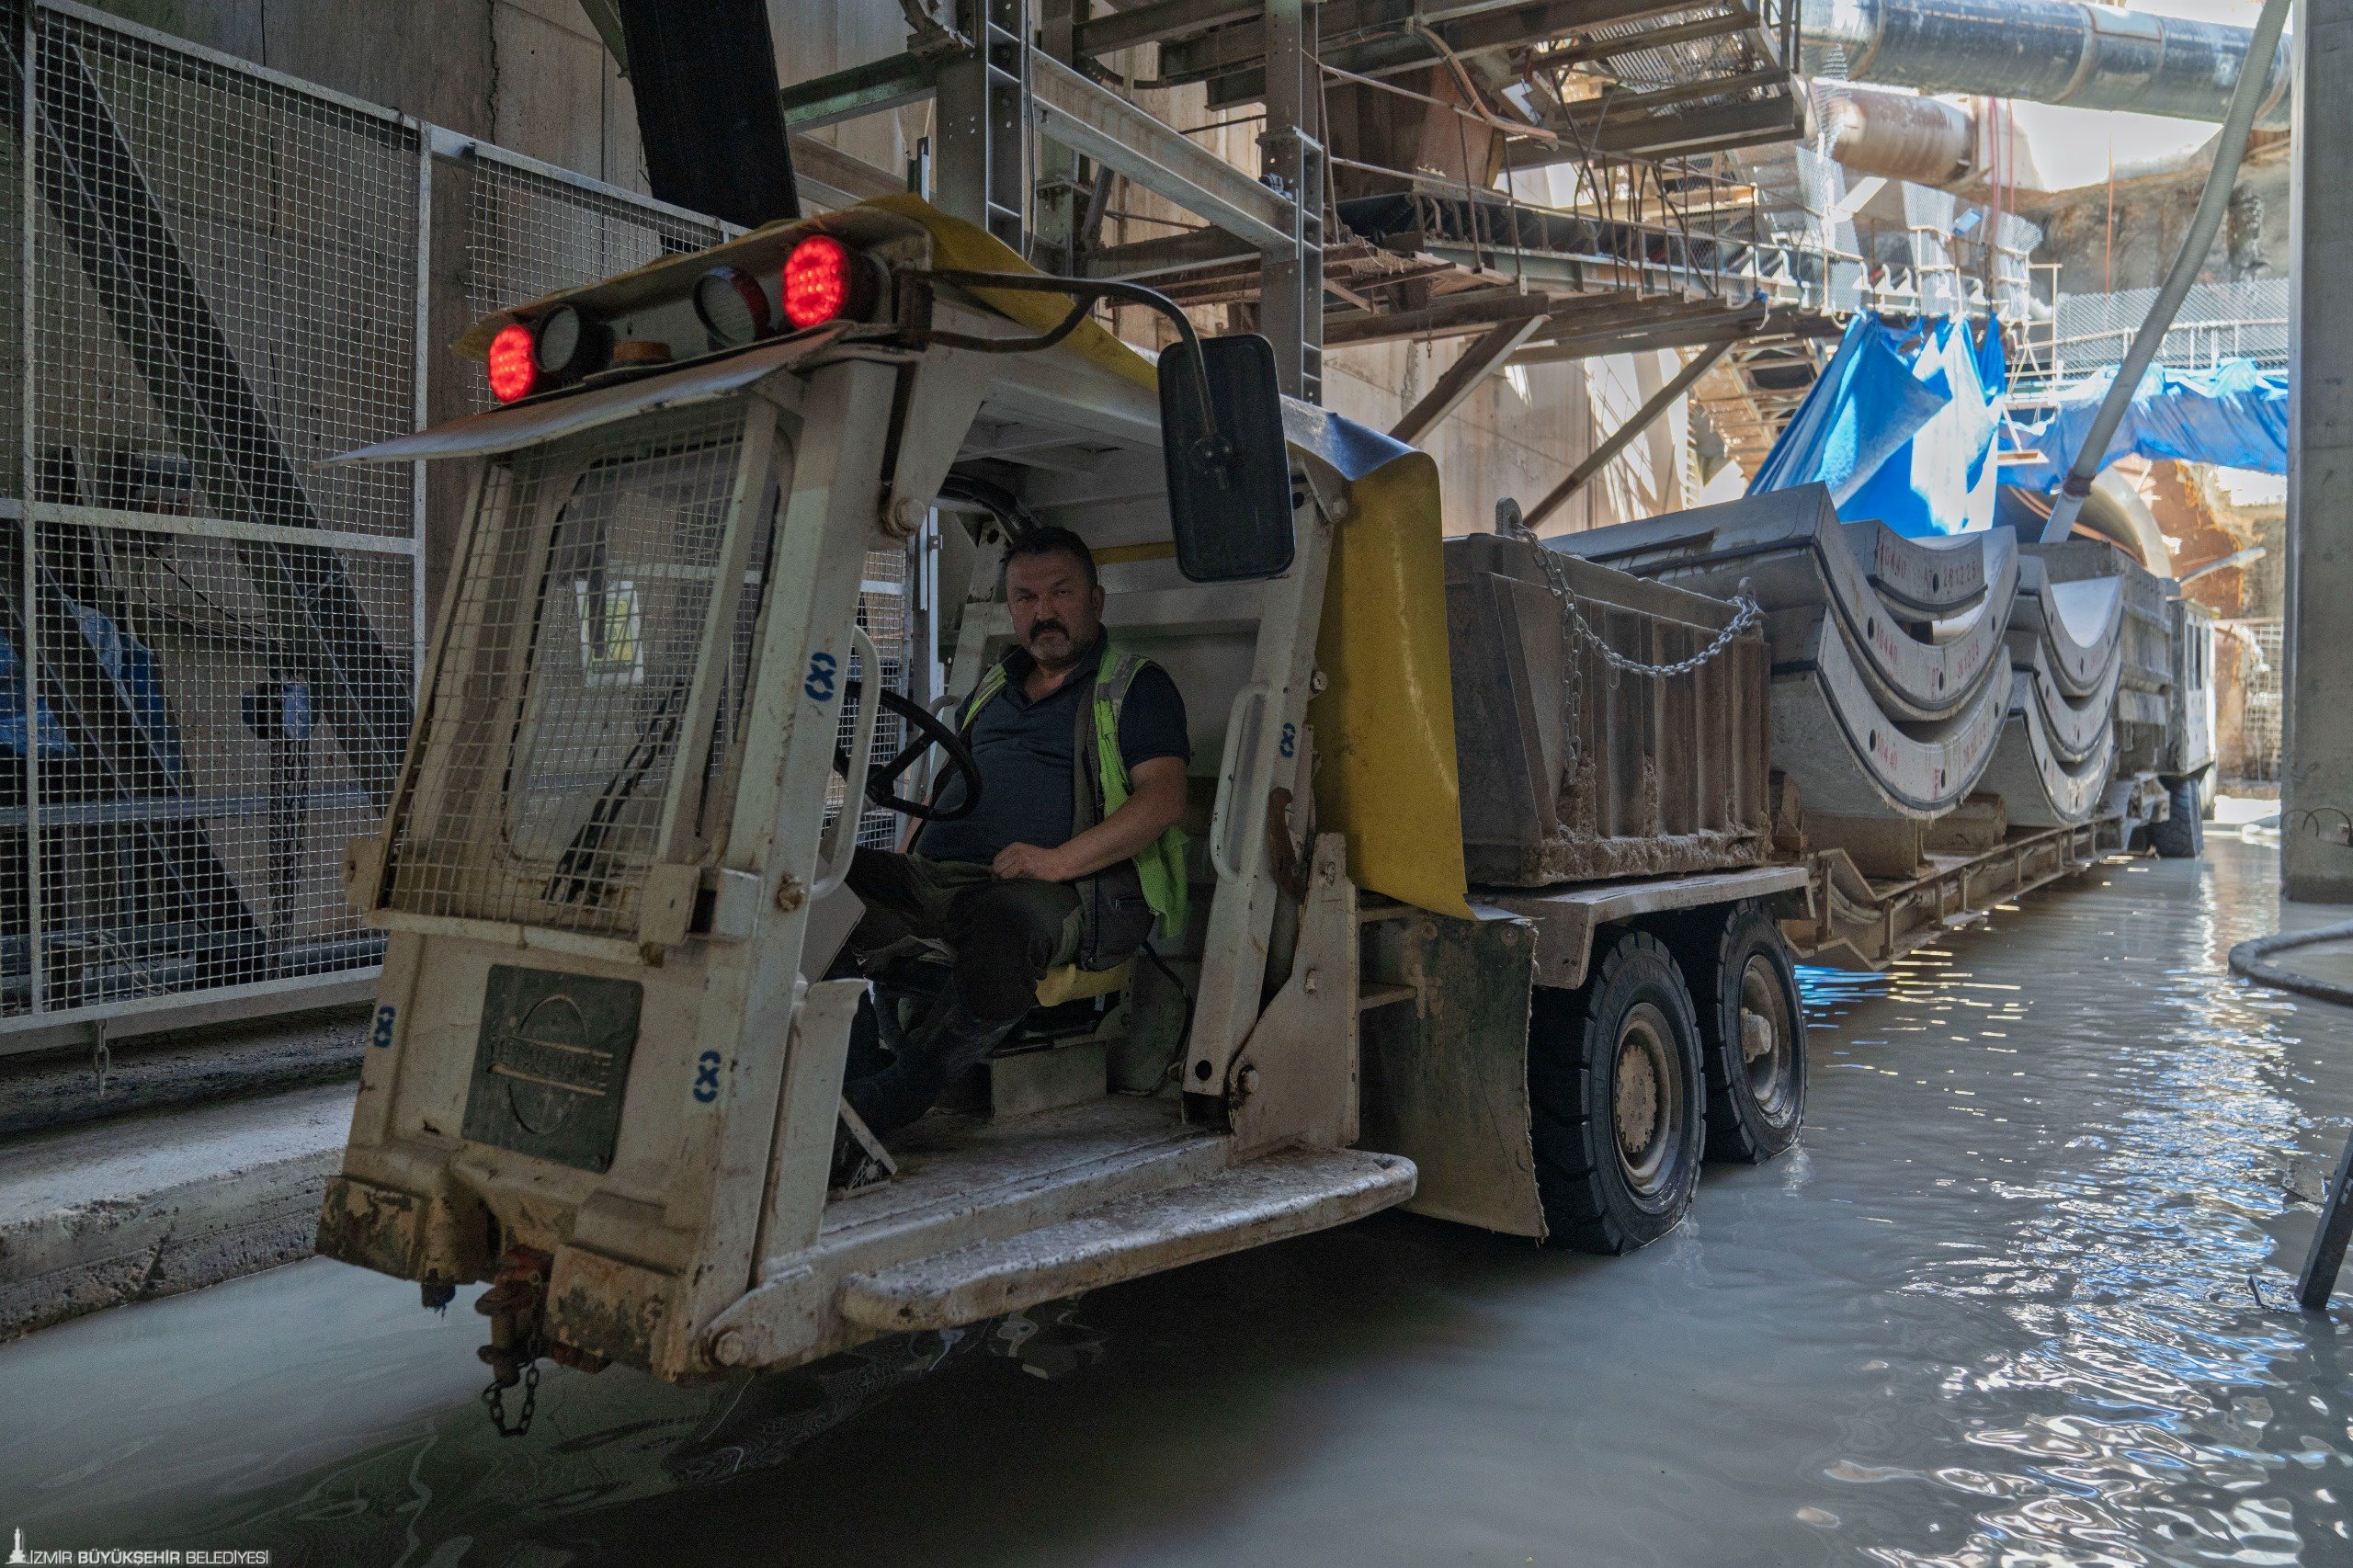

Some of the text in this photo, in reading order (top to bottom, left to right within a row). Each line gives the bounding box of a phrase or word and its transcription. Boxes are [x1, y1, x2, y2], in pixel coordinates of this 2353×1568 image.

[805, 652, 837, 701] 8
[1279, 722, 1295, 758] 8
[373, 1006, 395, 1048] 8
[693, 1051, 721, 1103] 8
